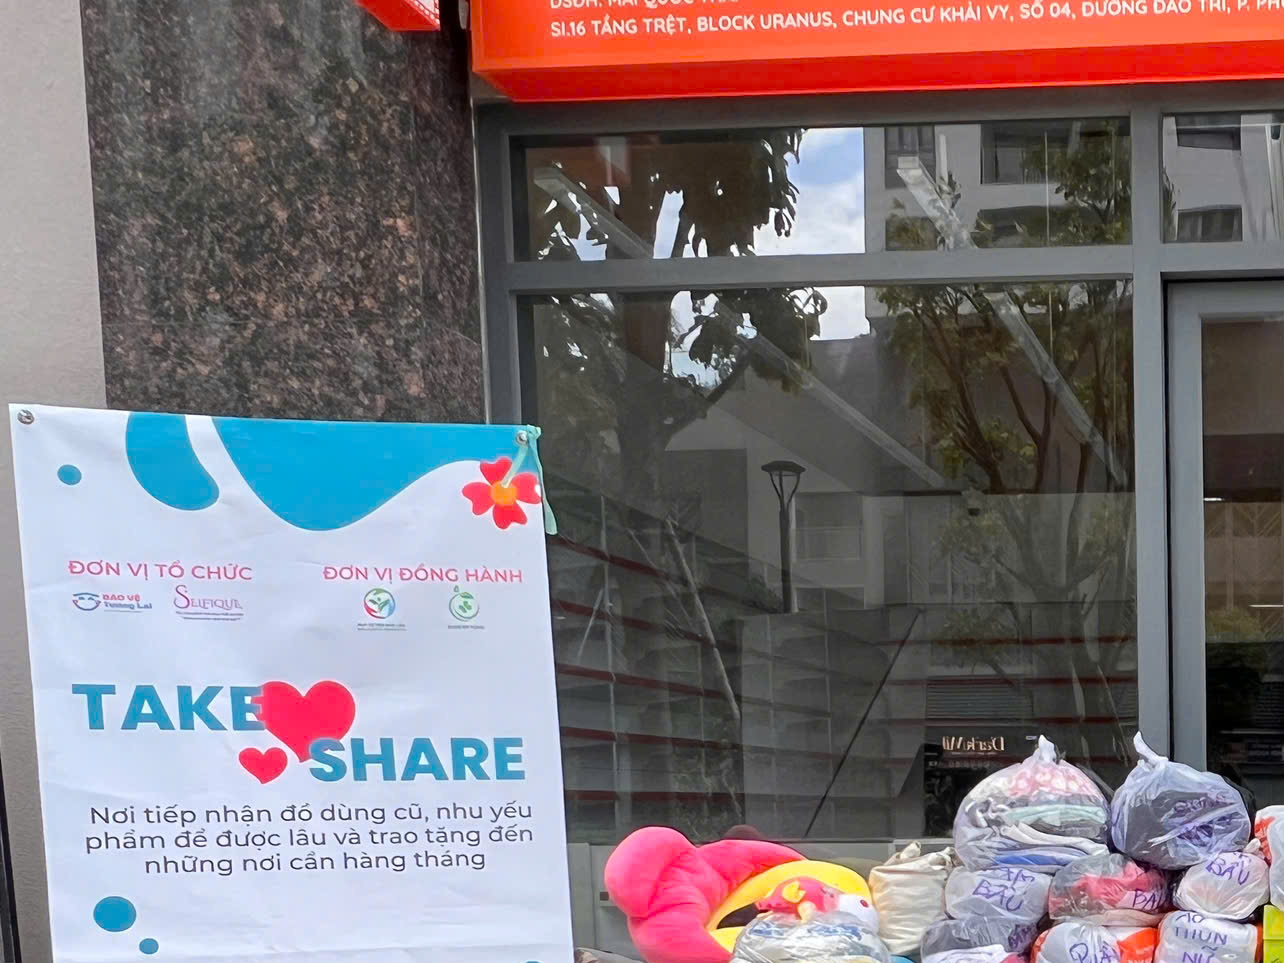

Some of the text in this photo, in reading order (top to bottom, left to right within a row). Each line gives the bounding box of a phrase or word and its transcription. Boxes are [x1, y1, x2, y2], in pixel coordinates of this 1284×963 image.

[697, 15, 755, 33] BLOCK
[760, 12, 838, 30] URANUS,
[842, 9, 905, 27] CHUNG
[1049, 2, 1077, 20] 04,
[68, 560, 120, 576] ĐƠN
[127, 562, 149, 581] VỊ
[191, 562, 253, 580] CHỨC
[323, 564, 369, 580] ĐƠN
[374, 566, 393, 584] VỊ
[465, 565, 524, 583] HÀNH
[72, 684, 266, 731] TAKE
[309, 737, 526, 782] SHARE
[90, 805, 135, 825] Nơi
[143, 803, 197, 827] tiếp
[205, 805, 272, 826] nhận
[320, 804, 386, 824] dùng
[394, 803, 429, 822] cũ,
[437, 803, 482, 820] nhu
[490, 800, 532, 822] yếu
[216, 831, 281, 851] được
[289, 828, 326, 846] lâu
[333, 828, 361, 845] và
[369, 829, 418, 844] trao
[425, 826, 481, 847] tặng
[488, 824, 533, 842] đến
[145, 855, 233, 876] những
[243, 853, 281, 871] nơi
[343, 851, 406, 872] hàng
[414, 849, 486, 870] tháng
